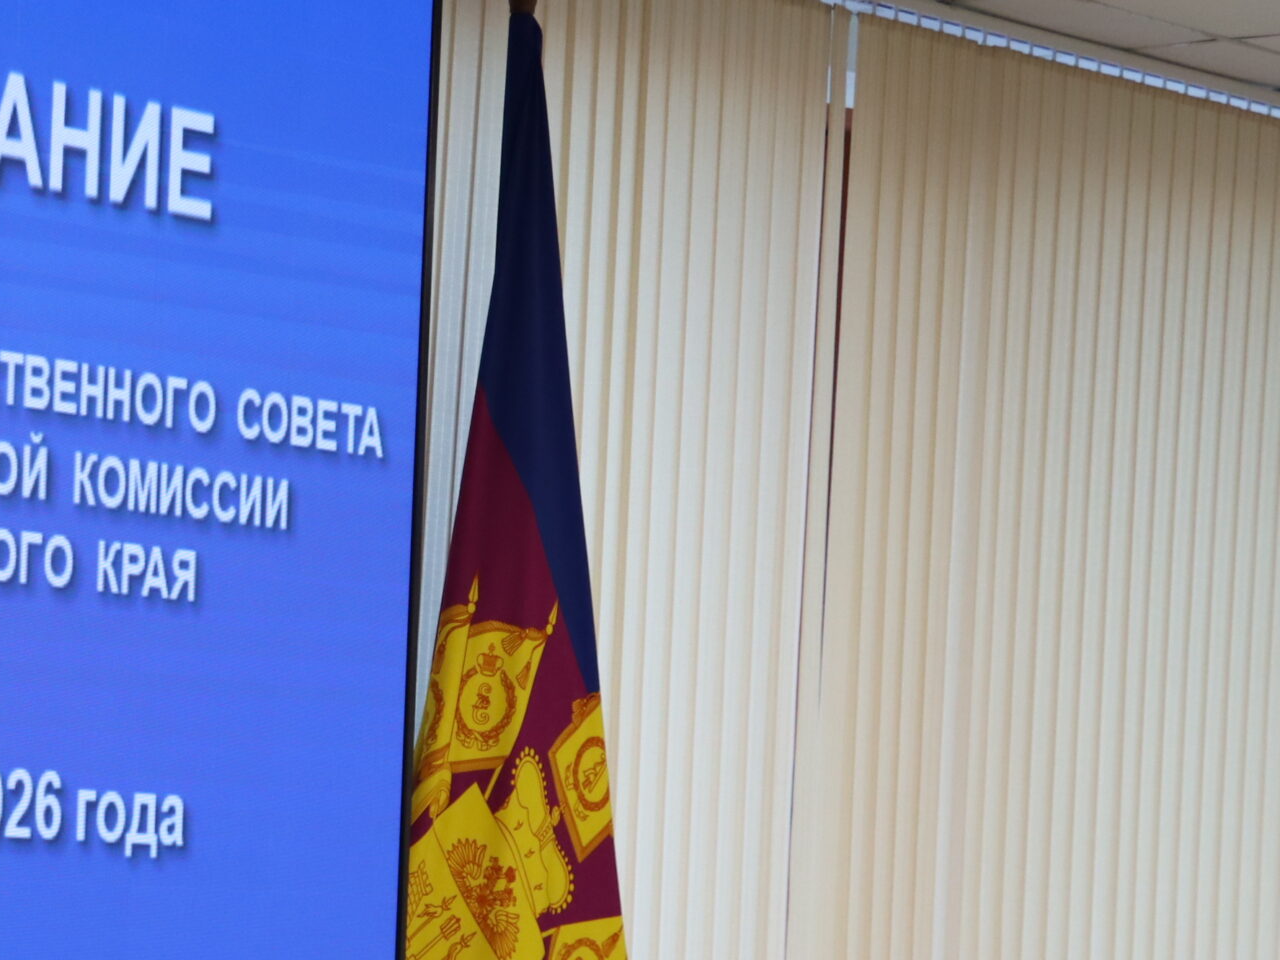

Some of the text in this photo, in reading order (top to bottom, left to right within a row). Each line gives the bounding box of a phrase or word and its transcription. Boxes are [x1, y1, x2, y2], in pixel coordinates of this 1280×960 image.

[236, 388, 384, 459] СОВЕТА
[72, 451, 290, 531] КОМИССИИ
[95, 540, 197, 603] КРАЯ
[75, 789, 185, 859] года
